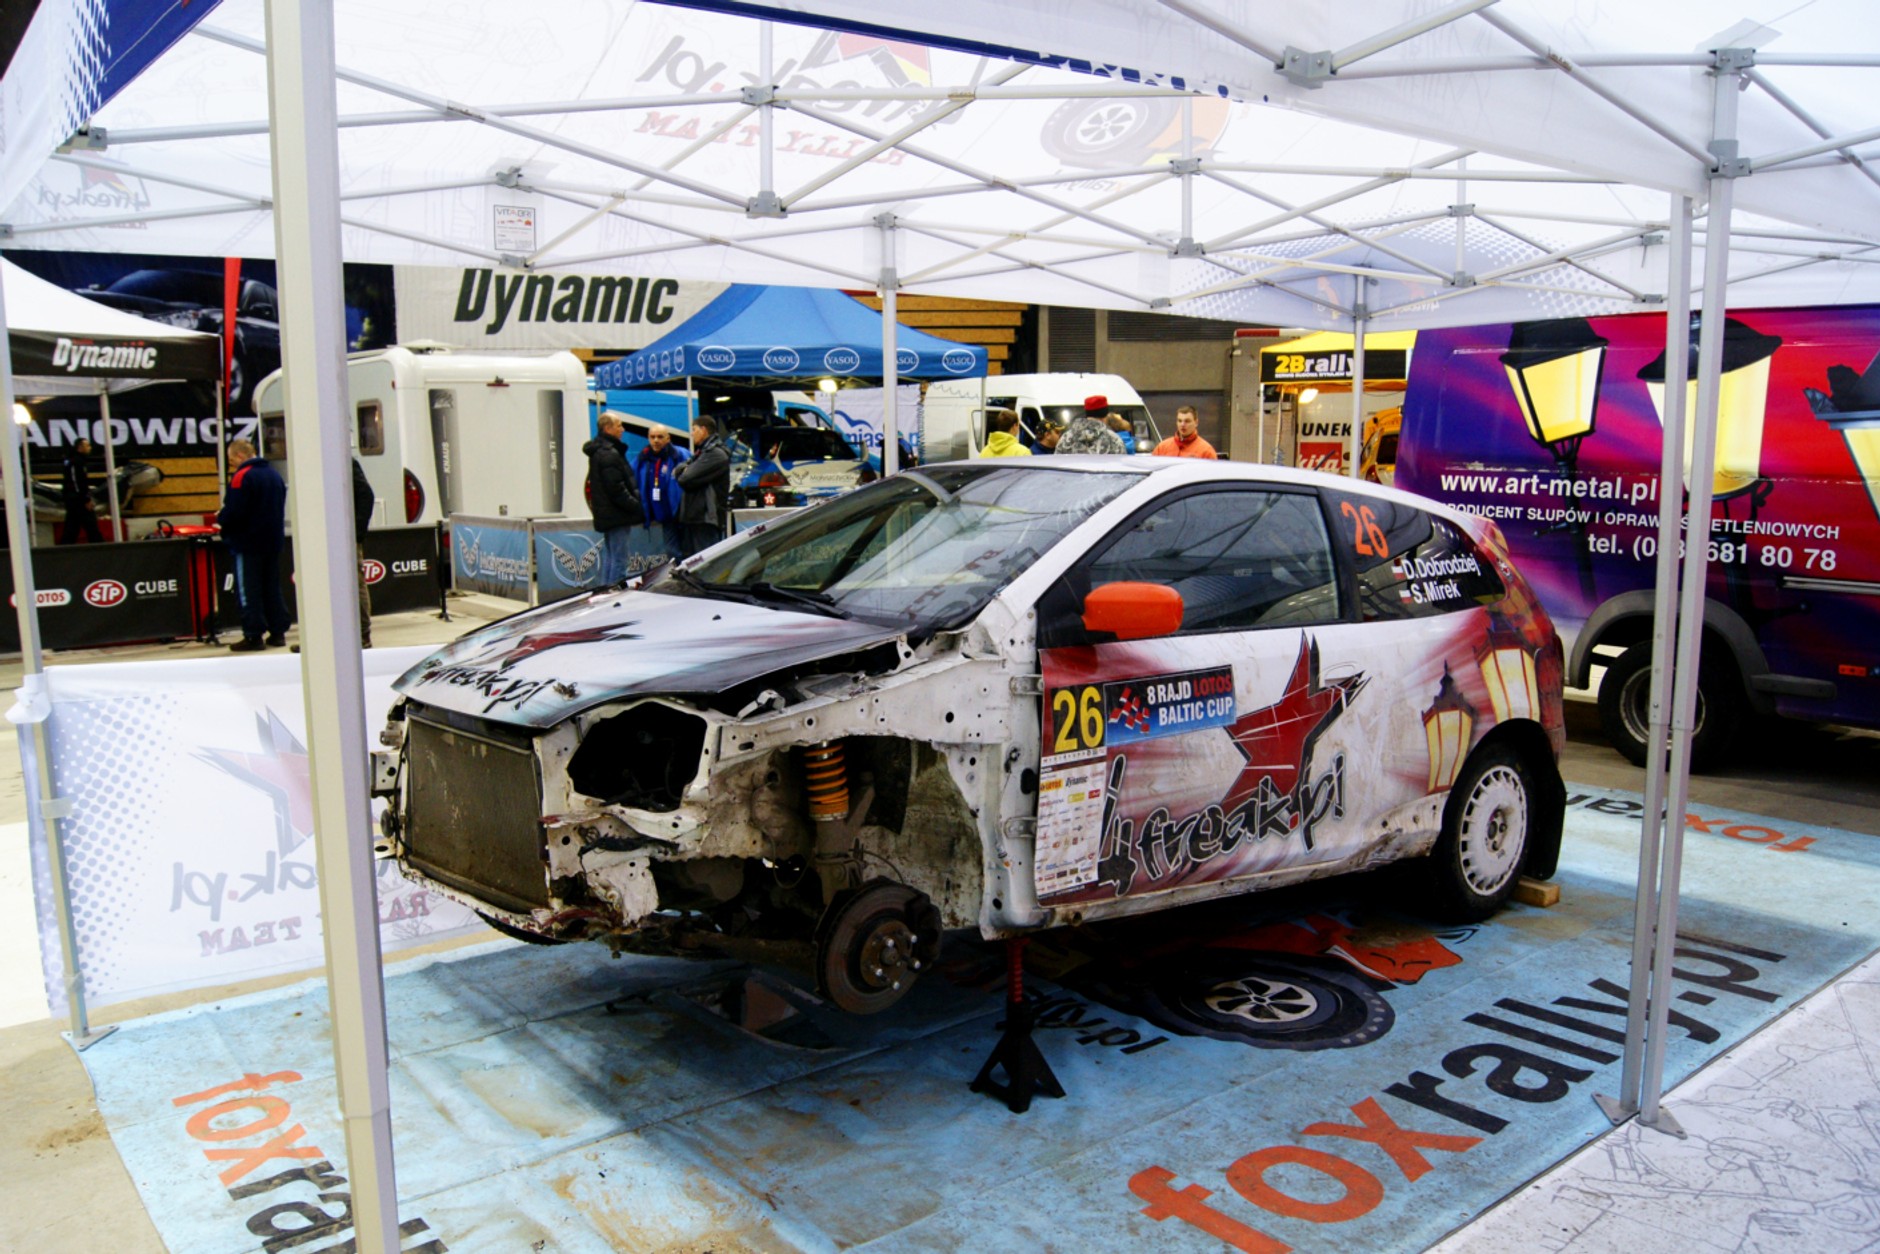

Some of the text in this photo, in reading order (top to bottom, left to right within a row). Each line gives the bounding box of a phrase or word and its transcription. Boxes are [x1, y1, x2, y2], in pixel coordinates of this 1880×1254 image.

[454, 268, 679, 335] Dynamic
[52, 337, 158, 372] Dynamic
[701, 353, 732, 363] YASOU
[766, 354, 796, 364] YASOU
[827, 355, 857, 365] YASOU
[1441, 471, 1656, 506] www.art-metal.pl
[1340, 501, 1389, 558] 26
[1527, 506, 1591, 523] SŁUPÓW
[1595, 511, 1599, 524] I
[391, 559, 427, 573] CUBE
[1588, 533, 1623, 554] tel.
[1707, 540, 1748, 564] 681
[1760, 545, 1793, 567] 80
[1803, 548, 1837, 571] 78
[37, 579, 178, 603] OTOS STP CUBE
[1147, 674, 1232, 705] 8 RAJD LOTOS
[1053, 686, 1104, 754] 26
[1158, 696, 1233, 726] BALTIC CUP
[1127, 924, 1788, 1254] foxrally.pl
